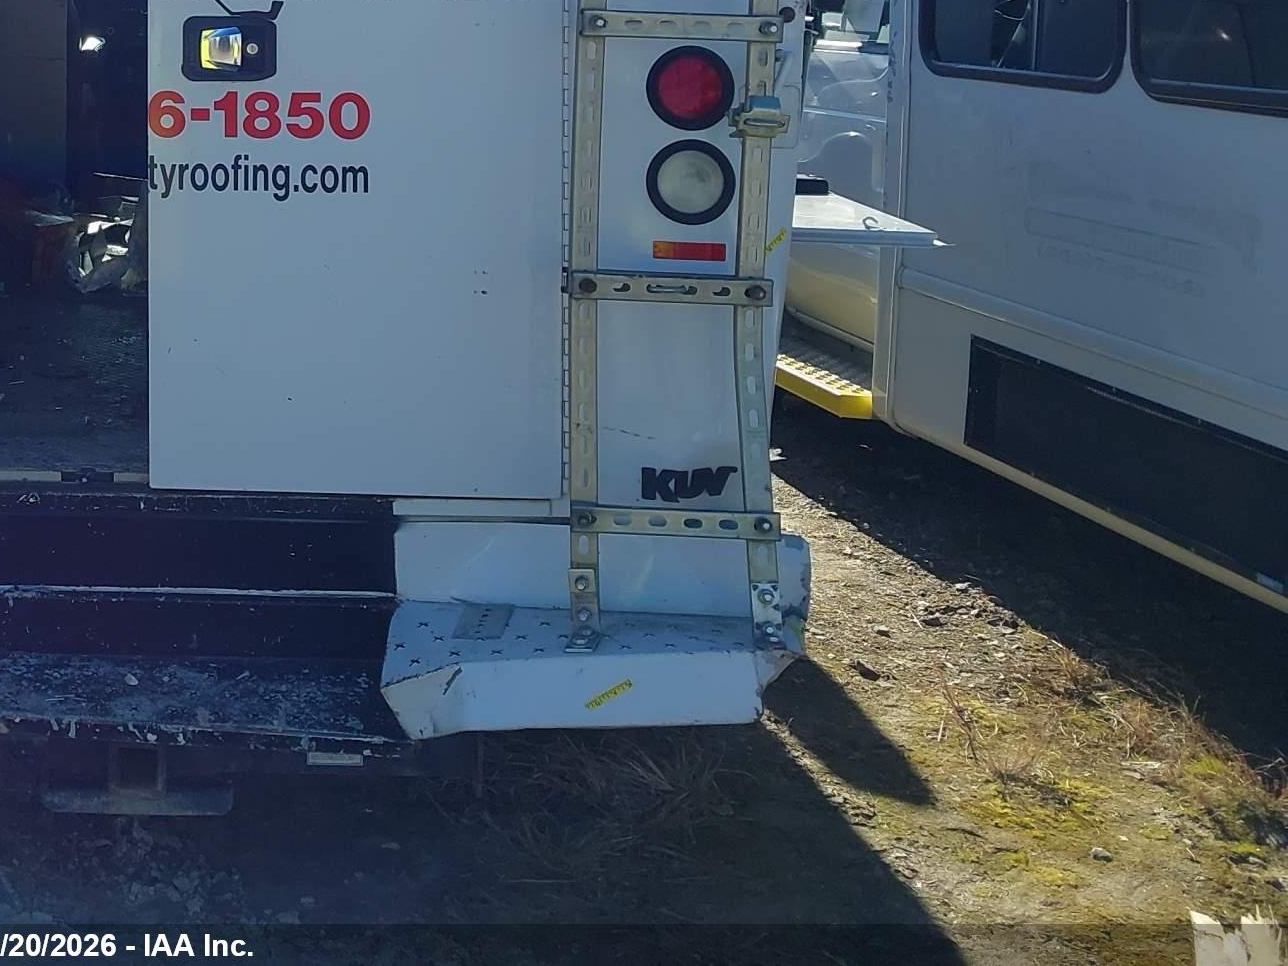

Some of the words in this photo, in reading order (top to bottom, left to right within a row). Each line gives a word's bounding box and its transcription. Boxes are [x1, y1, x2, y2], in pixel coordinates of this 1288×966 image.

[148, 90, 370, 139] 6-1850
[149, 154, 369, 201] tyroofing.com
[641, 465, 738, 503] KUV
